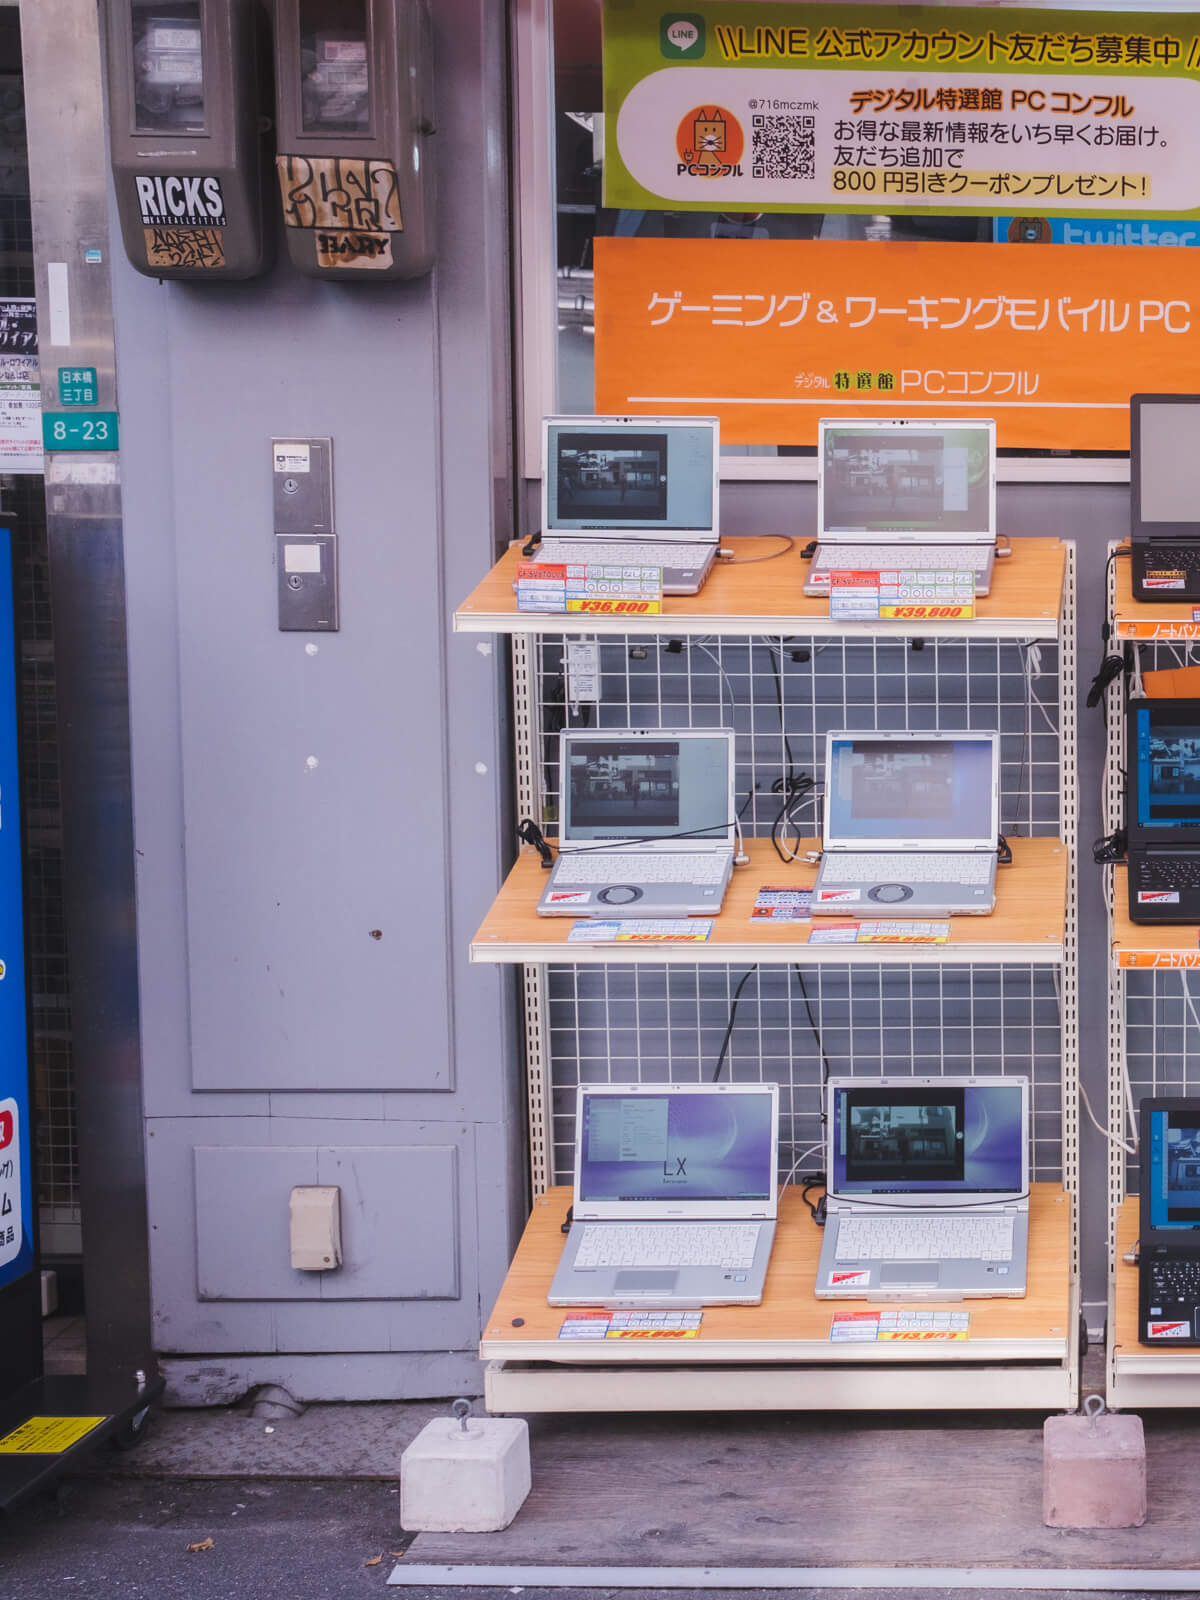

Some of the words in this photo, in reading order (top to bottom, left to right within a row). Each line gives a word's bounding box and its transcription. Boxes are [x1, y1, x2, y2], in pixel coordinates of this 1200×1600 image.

[672, 30, 694, 39] LINE
[749, 100, 819, 111] @716mczmk
[834, 119, 1167, 148] お得な最新情報をいち早くお届け。
[834, 146, 963, 168] 友だち追加で
[677, 164, 743, 177] PCコンフル
[136, 176, 224, 218] RICKS
[1064, 222, 1196, 247] twitter
[62, 371, 93, 384] 日本橋
[901, 369, 1040, 395] PCコンフル
[63, 388, 93, 401] 三丁目
[54, 420, 109, 441] 8-23
[579, 600, 650, 613] ¥36,800
[893, 607, 962, 618] ¥39,800
[664, 1157, 687, 1176] LX
